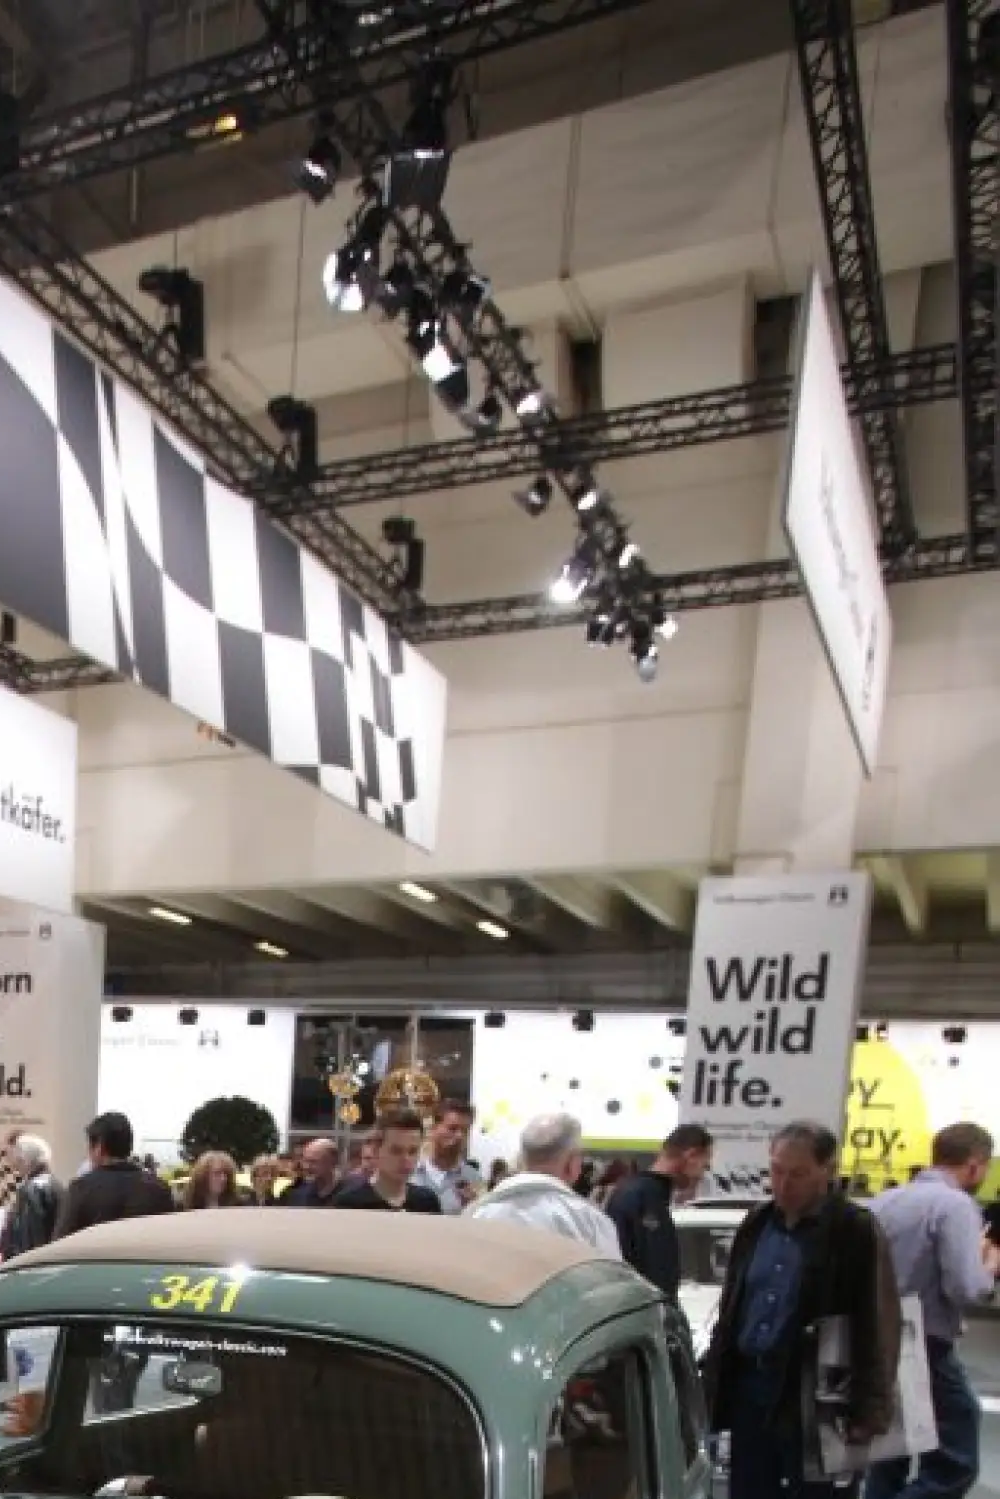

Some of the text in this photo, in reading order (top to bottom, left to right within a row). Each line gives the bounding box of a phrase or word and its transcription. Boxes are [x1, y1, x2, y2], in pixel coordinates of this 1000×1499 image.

[705, 951, 829, 1002] Wild
[699, 1006, 816, 1054] wild
[692, 1059, 783, 1107] life.
[151, 1275, 243, 1312] 341
